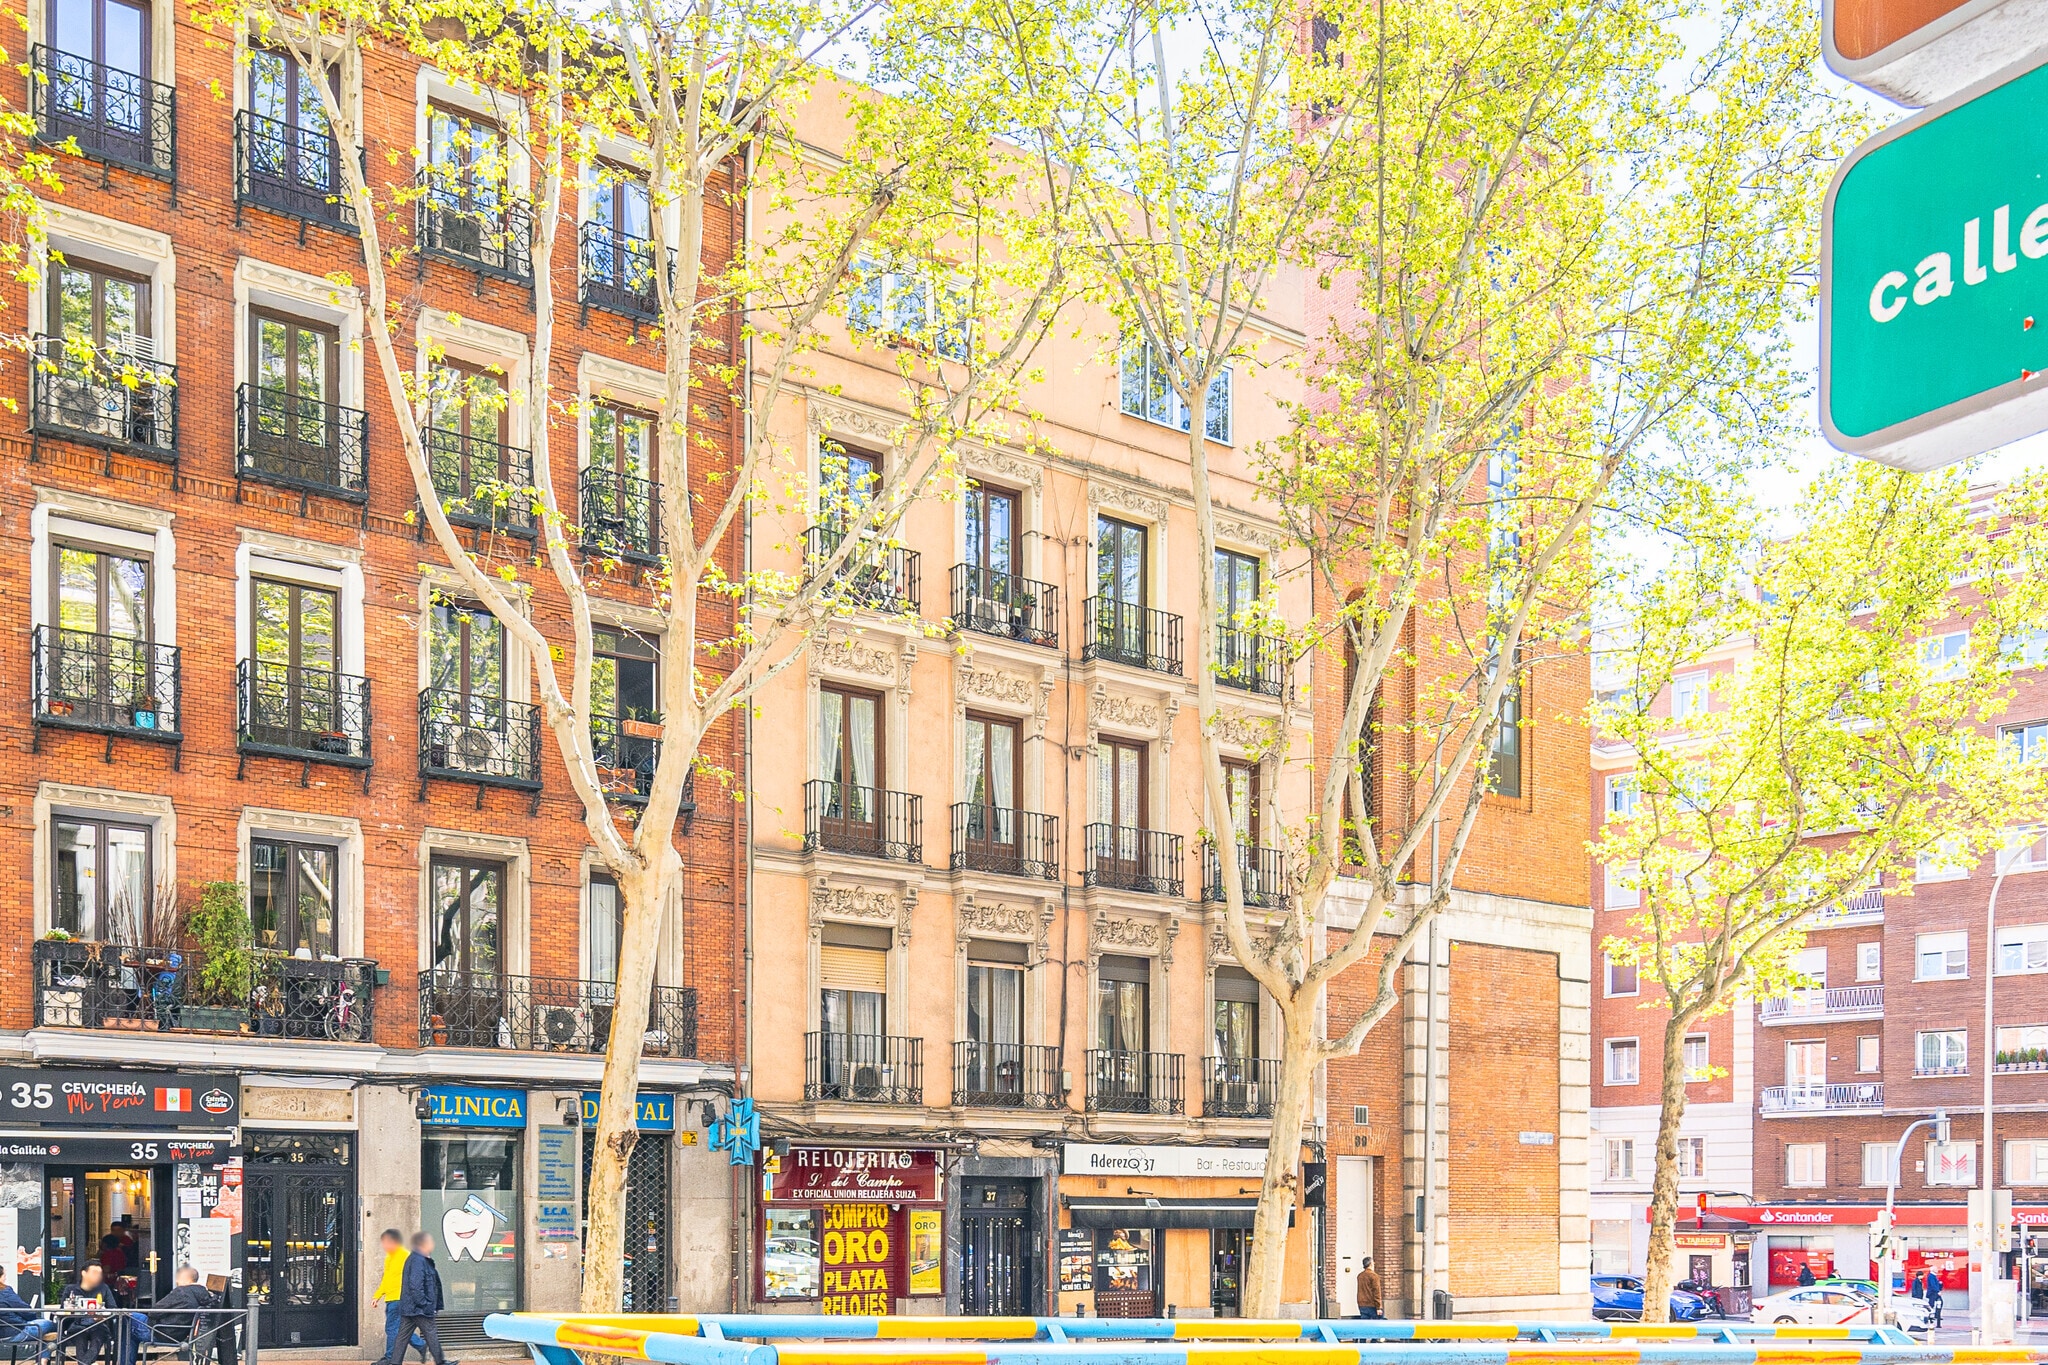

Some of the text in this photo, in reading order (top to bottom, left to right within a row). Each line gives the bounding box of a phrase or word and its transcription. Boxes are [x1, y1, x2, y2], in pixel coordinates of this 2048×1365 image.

[1869, 203, 2048, 323] calle
[11, 1082, 53, 1109] 35
[62, 1082, 146, 1096] CEVICHERÍA
[67, 1092, 94, 1114] Mi
[583, 1100, 671, 1121] DTAL
[9, 1144, 47, 1155] Galicia
[130, 1143, 159, 1160] 35
[290, 1152, 304, 1163] 35
[798, 1150, 898, 1169] RELOJERIA
[1197, 1158, 1213, 1170] Bar
[1143, 1158, 1155, 1172] 37
[203, 1175, 217, 1186] MI
[831, 1176, 849, 1187] del
[856, 1173, 903, 1190] Campo
[203, 1186, 217, 1196] PE
[793, 1189, 916, 1199] EX OFICIAL UNION RELOJERA SUIZA
[986, 1191, 996, 1201] 37
[544, 1207, 570, 1216] E.C.A.
[823, 1203, 889, 1229] COMPRO
[1775, 1212, 1834, 1223] Santander
[915, 1221, 936, 1230] ORO
[824, 1229, 889, 1265] ORO
[823, 1269, 888, 1293] PLATA
